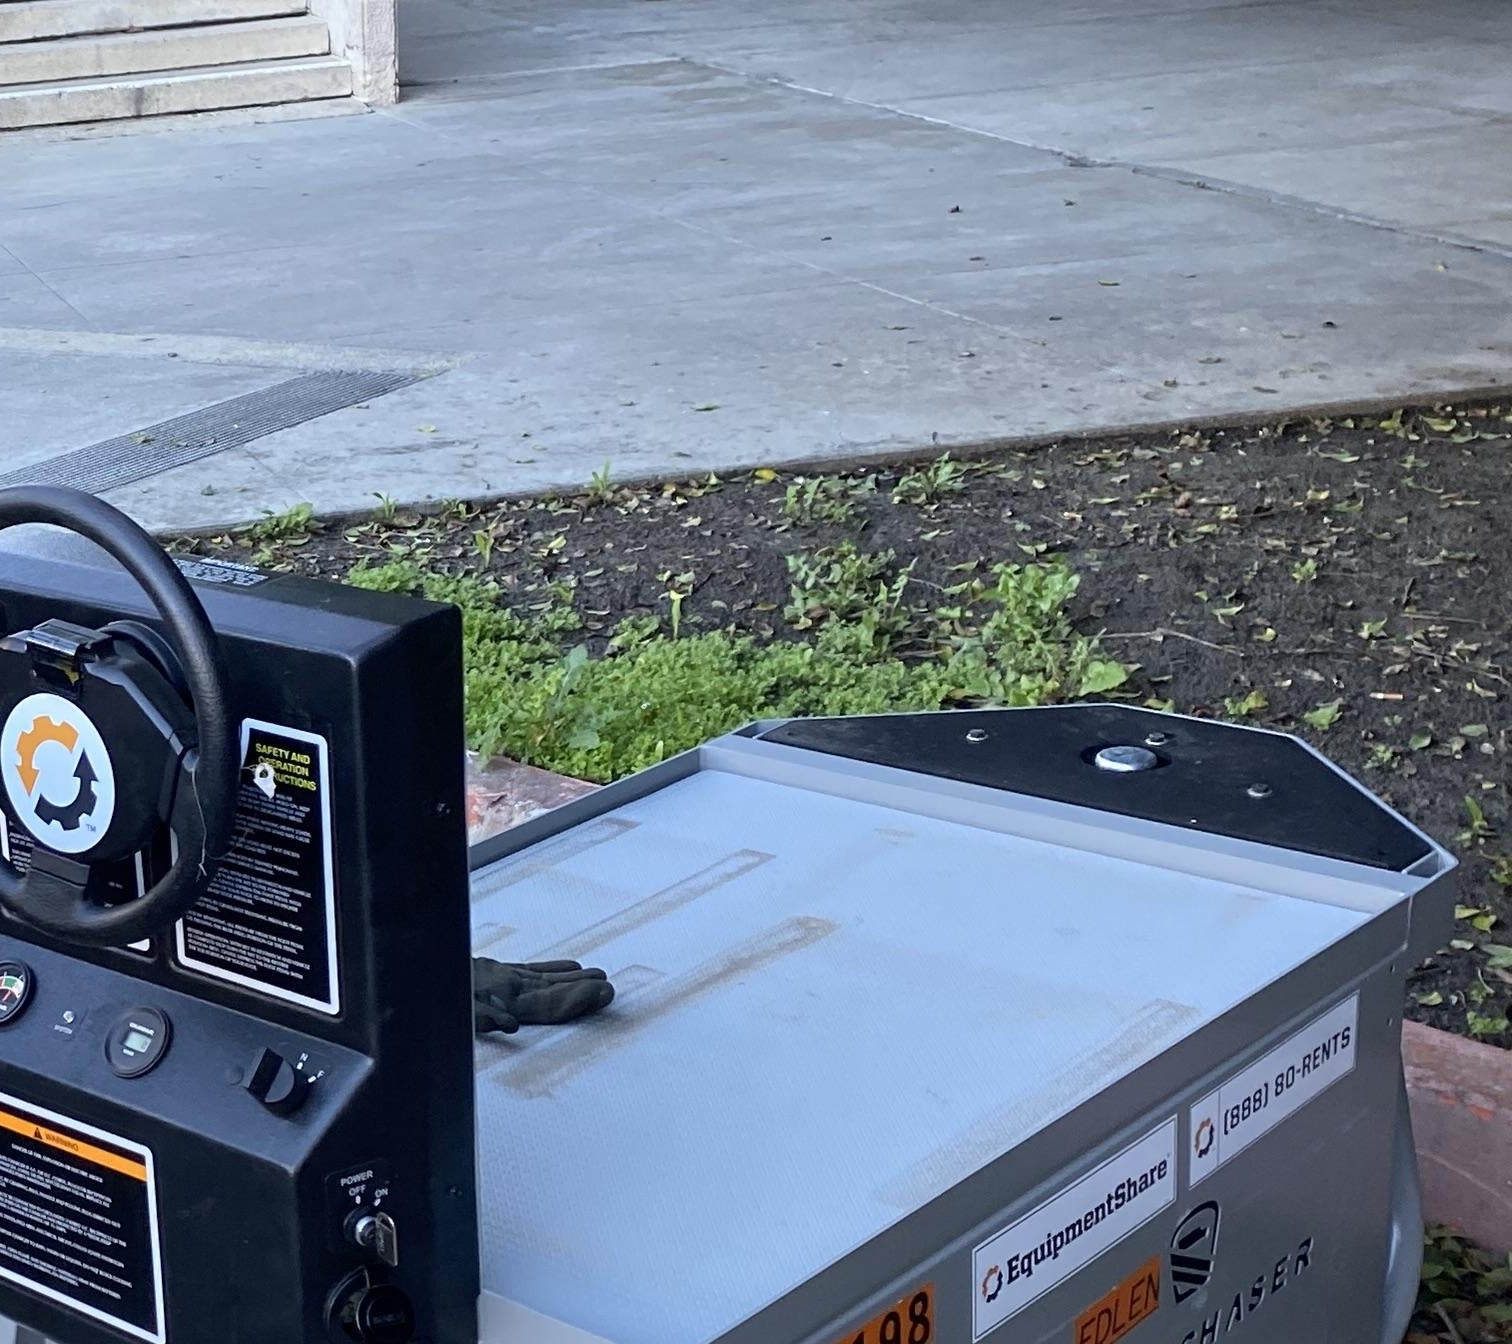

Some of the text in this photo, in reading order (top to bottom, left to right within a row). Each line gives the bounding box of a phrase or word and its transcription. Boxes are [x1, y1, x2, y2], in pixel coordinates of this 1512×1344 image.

[255, 742, 311, 765] SAFETY AND
[257, 755, 309, 777] OPERATION
[1223, 1025, 1351, 1135] (888) 80-RENTS
[44, 1130, 79, 1152] WARNING
[340, 1169, 374, 1187] POWER
[348, 1184, 389, 1198] OFF ON
[1006, 1158, 1168, 1285] EquipmentShare
